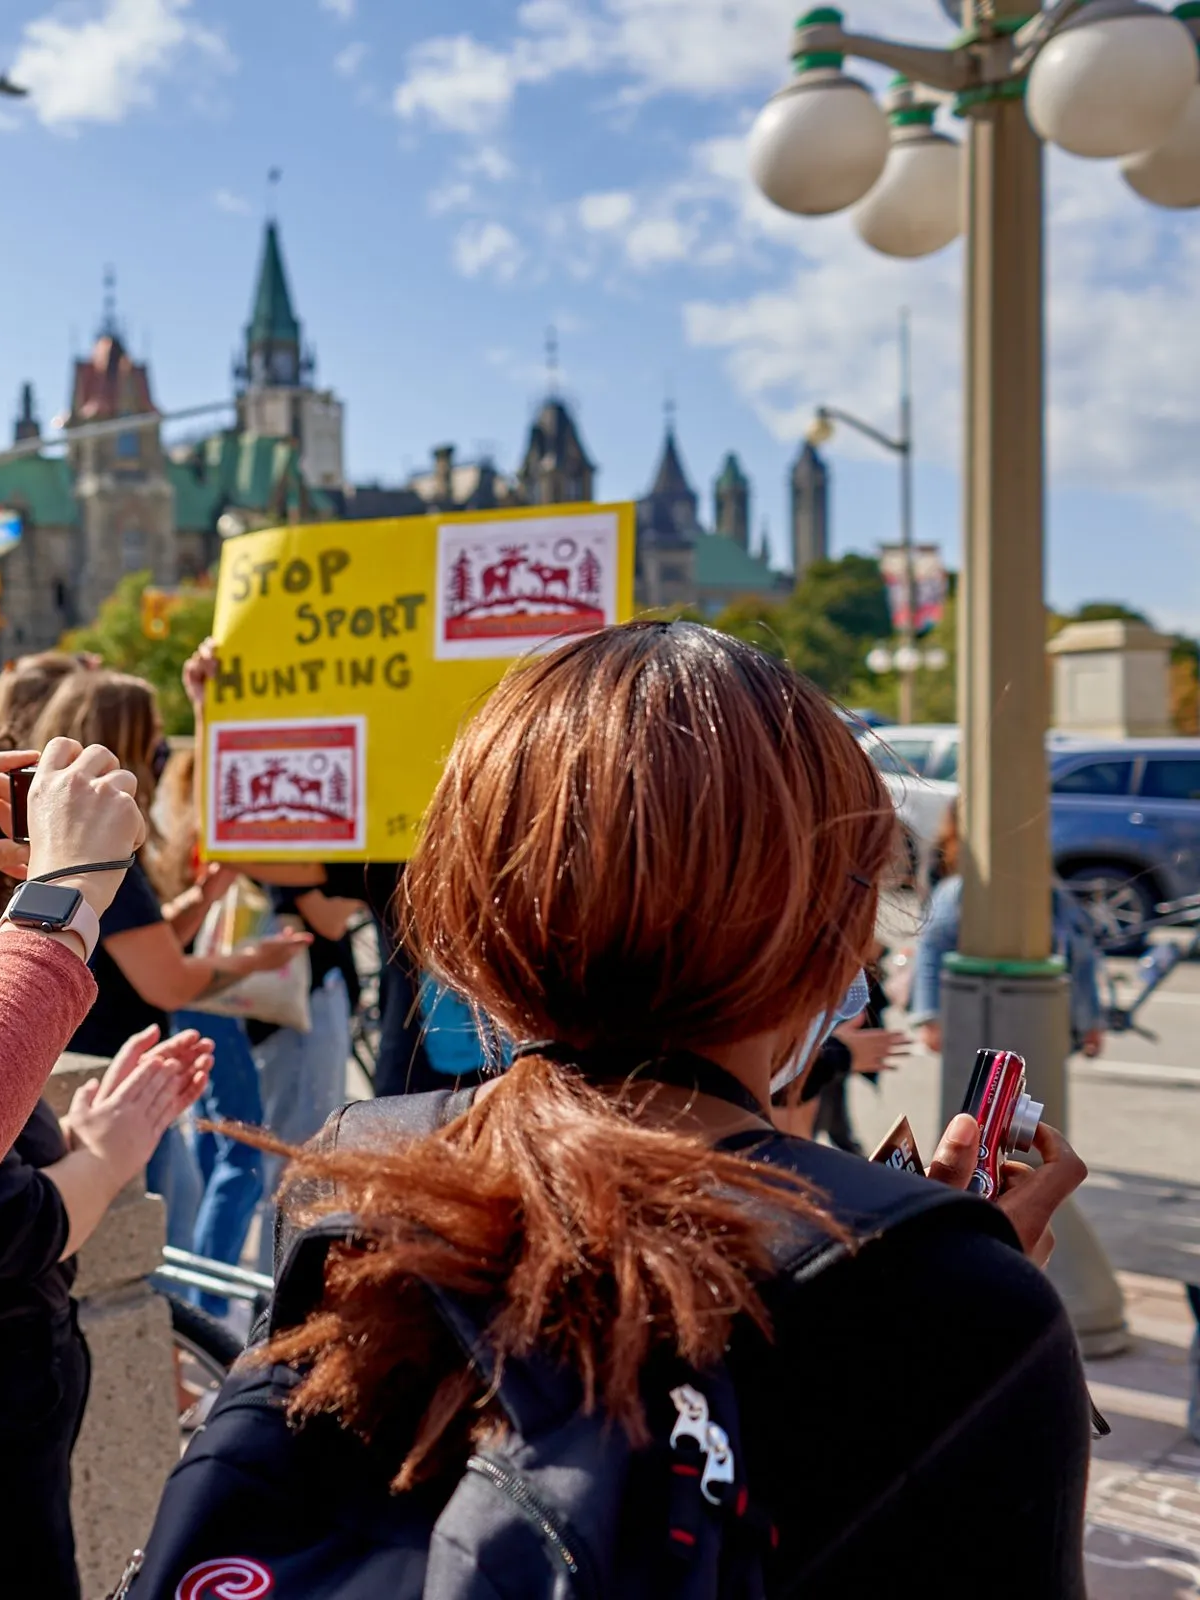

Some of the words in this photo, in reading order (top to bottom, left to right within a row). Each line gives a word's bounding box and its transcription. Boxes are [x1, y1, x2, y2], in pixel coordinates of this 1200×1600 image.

[232, 548, 351, 602] STOP
[294, 592, 428, 646] SPORT
[214, 652, 412, 706] HUNTING
